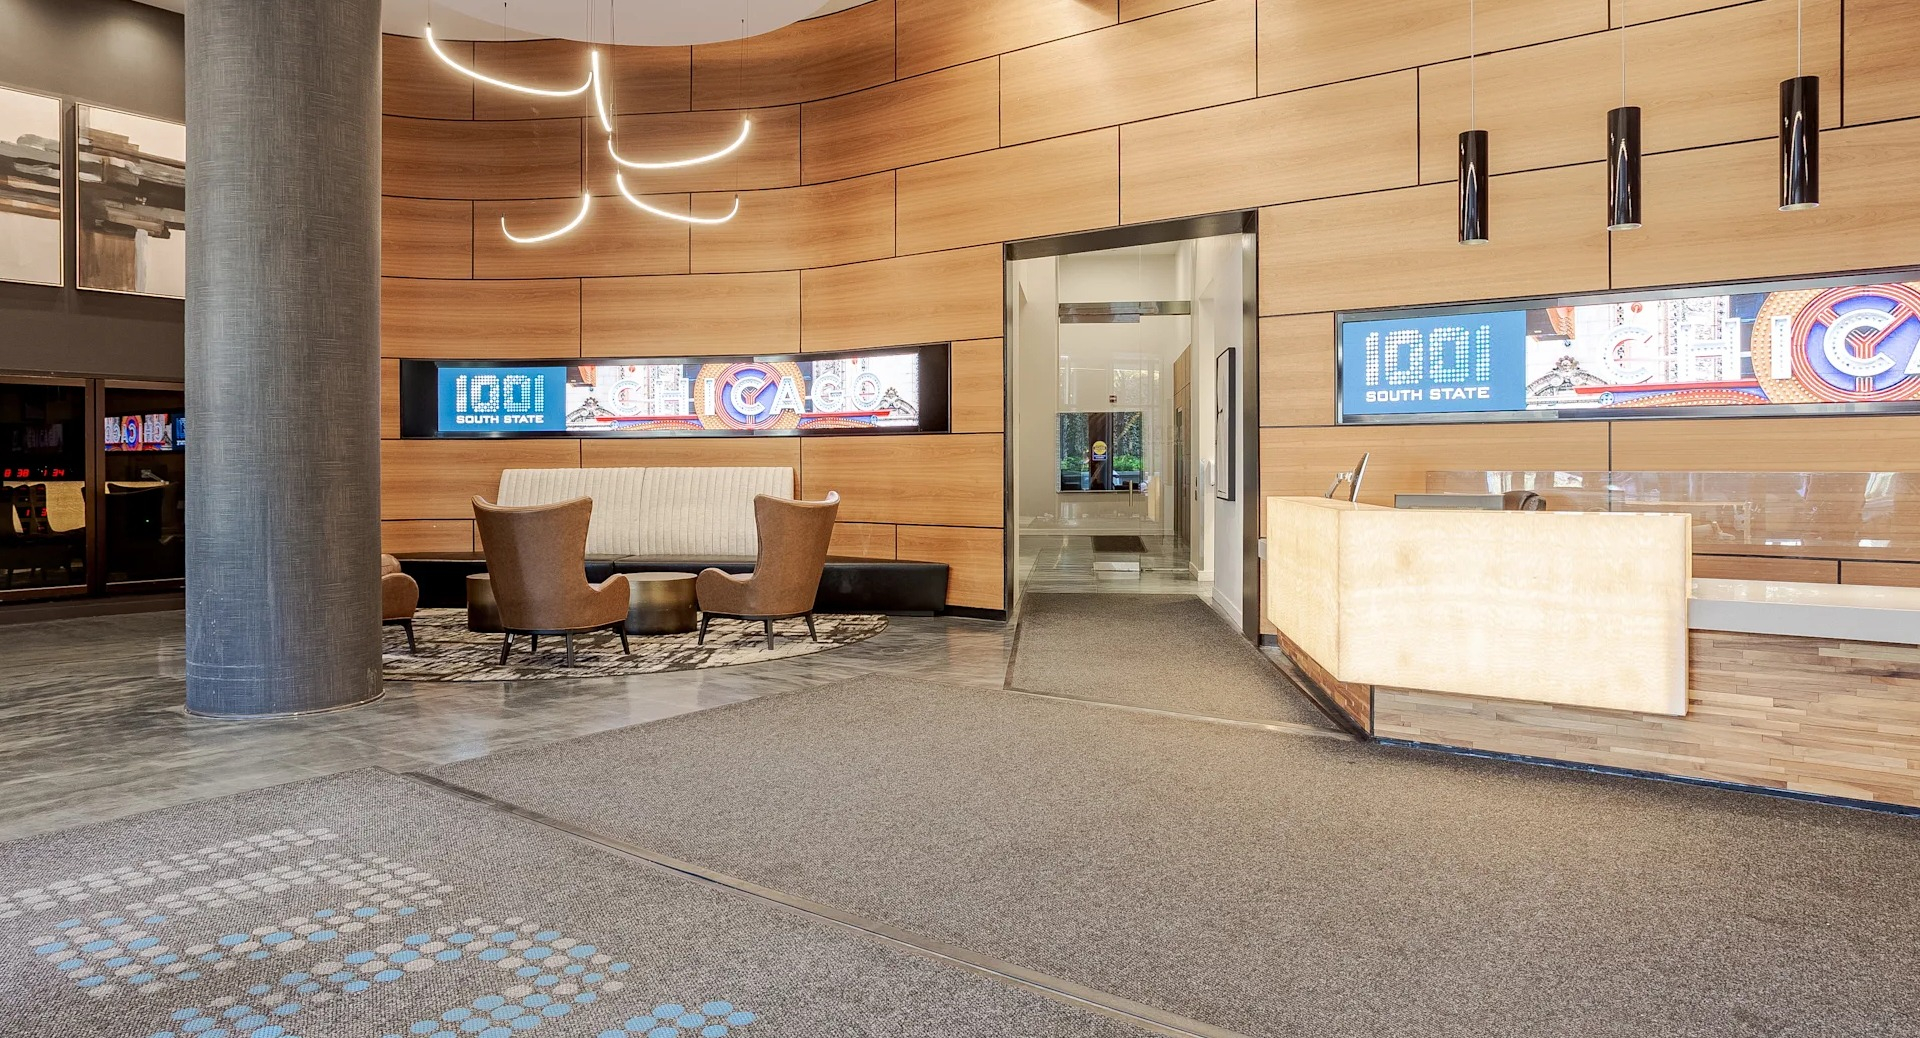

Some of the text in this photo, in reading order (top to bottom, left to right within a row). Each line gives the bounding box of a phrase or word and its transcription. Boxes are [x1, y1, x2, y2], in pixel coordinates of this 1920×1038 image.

[1366, 325, 1490, 386] 1001
[1603, 308, 1920, 385] CHIC
[455, 374, 544, 412] 1001
[608, 372, 882, 416] CHICAGO
[1366, 386, 1490, 402] SOUTH STATE
[456, 415, 544, 424] SOUTH STATE
